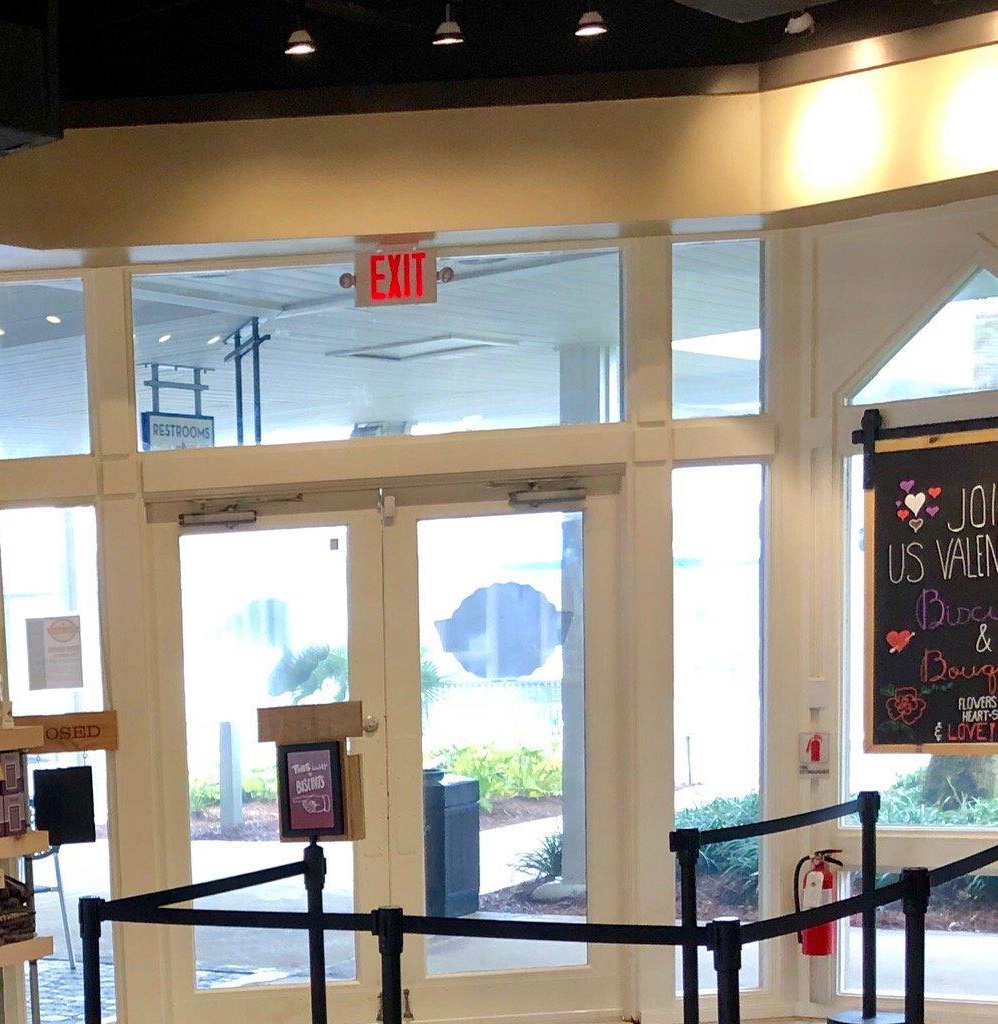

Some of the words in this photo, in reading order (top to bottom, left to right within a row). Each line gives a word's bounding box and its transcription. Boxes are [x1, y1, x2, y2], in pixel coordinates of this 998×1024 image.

[370, 252, 426, 300] EXIT
[153, 423, 210, 439] RESTROOMS
[888, 542, 925, 584] US
[976, 623, 992, 653] &
[44, 725, 101, 741] OSED
[295, 775, 326, 795] BISCUITS
